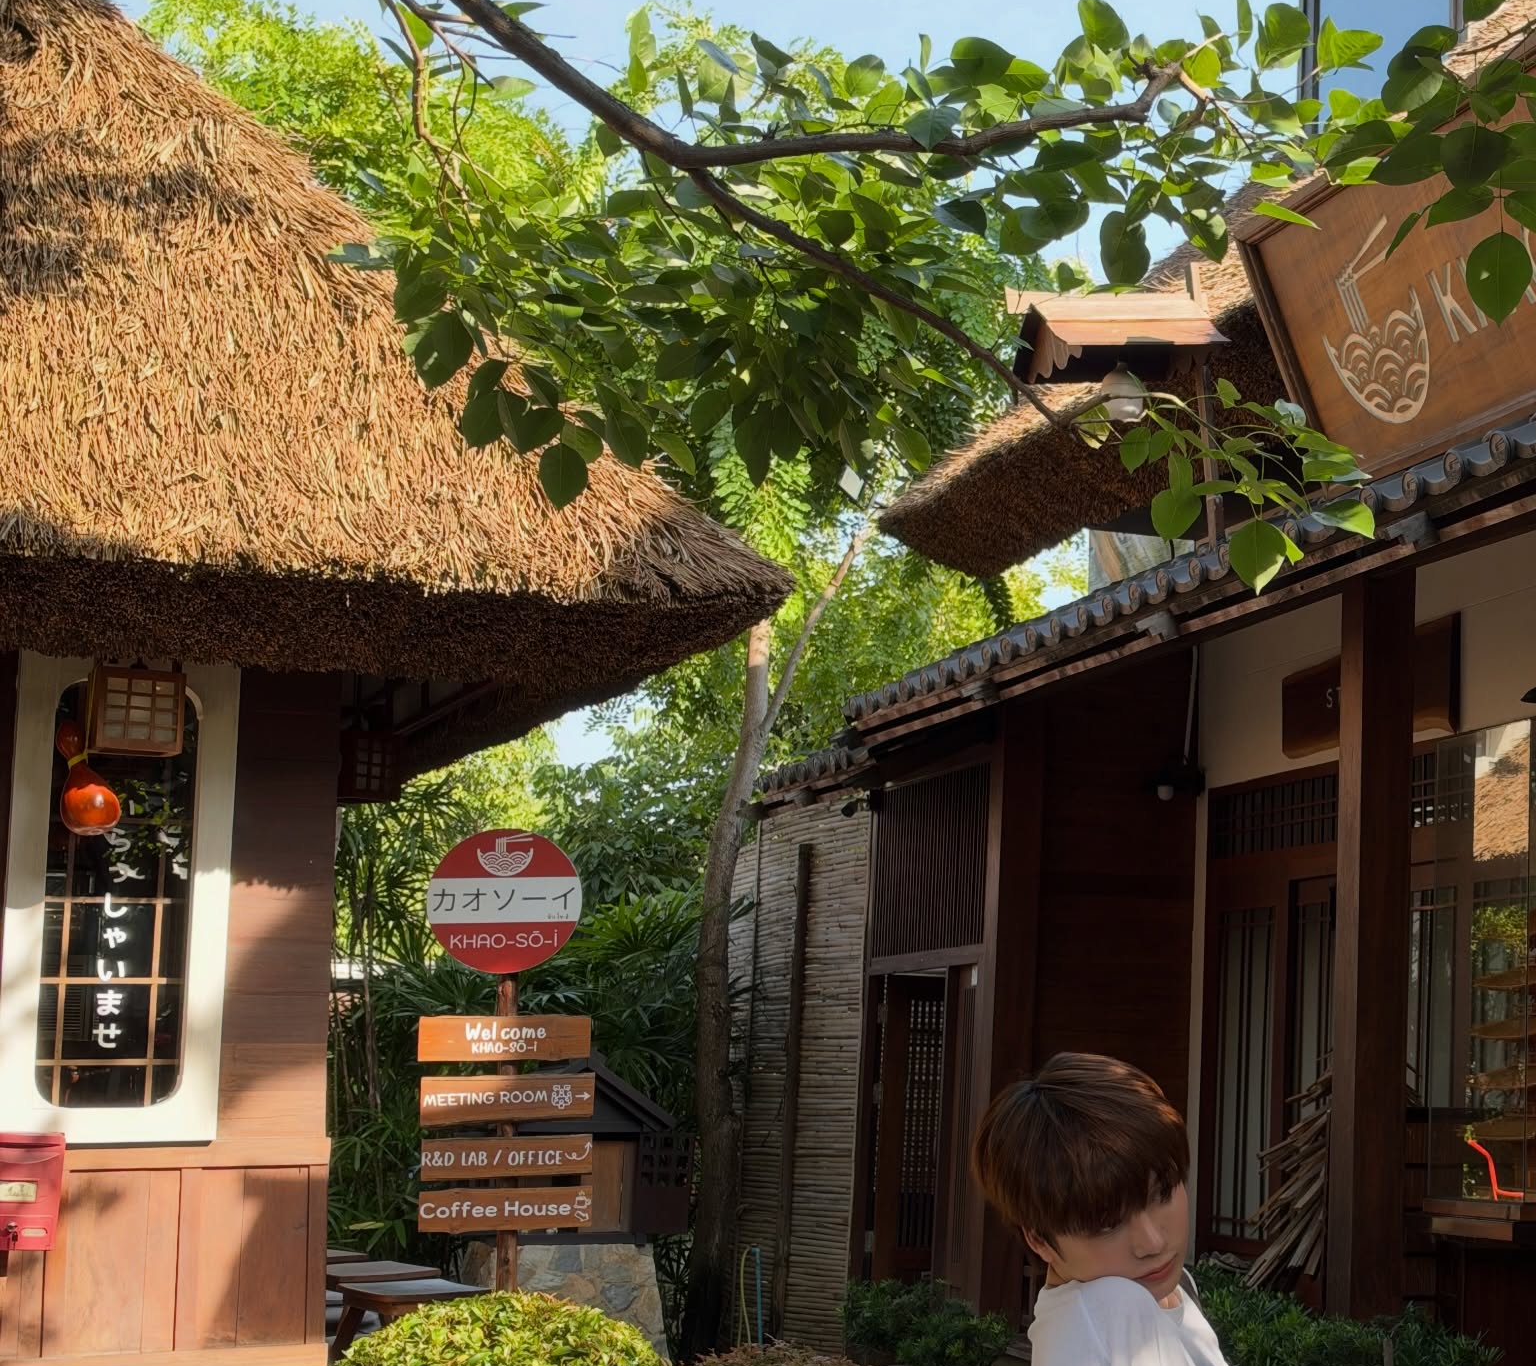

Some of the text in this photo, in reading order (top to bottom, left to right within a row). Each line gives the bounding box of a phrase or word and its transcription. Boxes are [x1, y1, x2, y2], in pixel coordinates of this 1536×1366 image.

[432, 887, 575, 912] カオソーイ
[465, 1021, 547, 1041] Welcome
[423, 1090, 548, 1107] MEETING ROOM
[421, 1149, 563, 1167] R&D LAB / OFFICE
[419, 1200, 571, 1219] Coffee House
